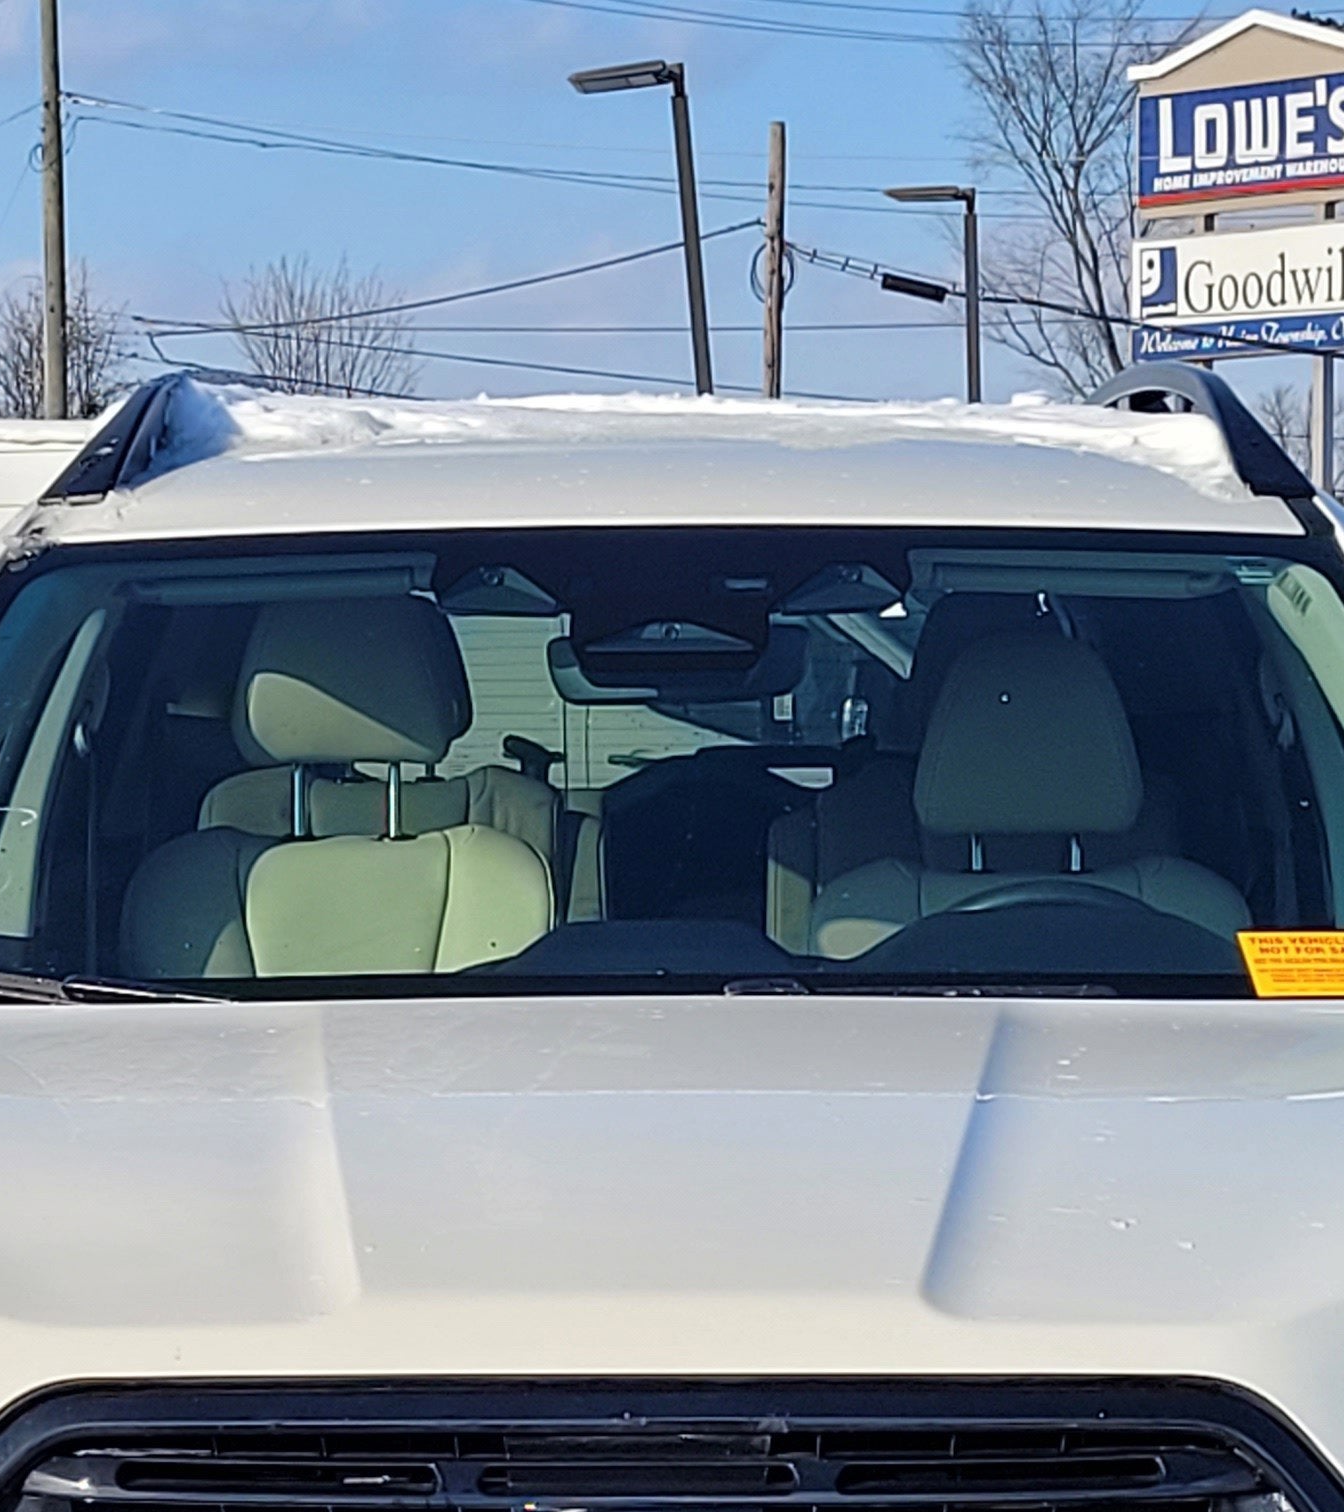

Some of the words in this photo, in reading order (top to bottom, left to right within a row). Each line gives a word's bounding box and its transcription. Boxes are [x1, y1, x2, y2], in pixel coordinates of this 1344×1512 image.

[1153, 174, 1190, 192] HOME
[1192, 164, 1284, 188] IMPROVEMENT
[1140, 330, 1199, 353] Welcome
[1201, 335, 1215, 348] to
[1249, 937, 1284, 945] THIS
[1259, 946, 1289, 955] NOT
[1294, 946, 1326, 955] FOR
